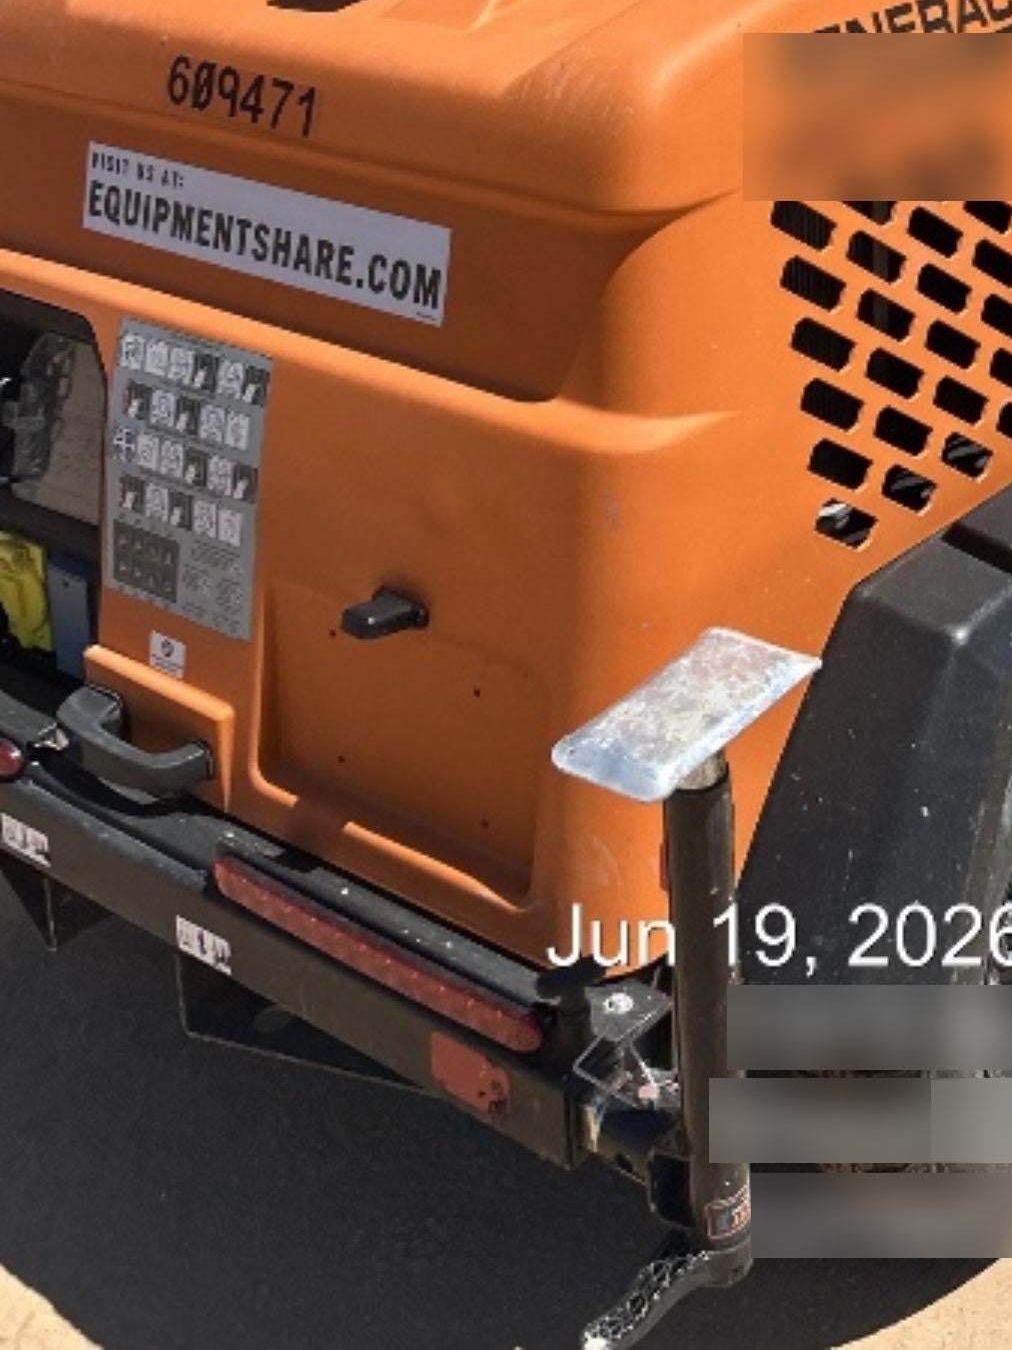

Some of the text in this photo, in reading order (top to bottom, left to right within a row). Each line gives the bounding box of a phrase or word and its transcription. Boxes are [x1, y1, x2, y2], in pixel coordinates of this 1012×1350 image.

[166, 55, 317, 138] 609471
[92, 152, 129, 177] VISIT
[137, 161, 155, 182] US
[88, 179, 442, 310] EQUIPMENTSHARE.COM
